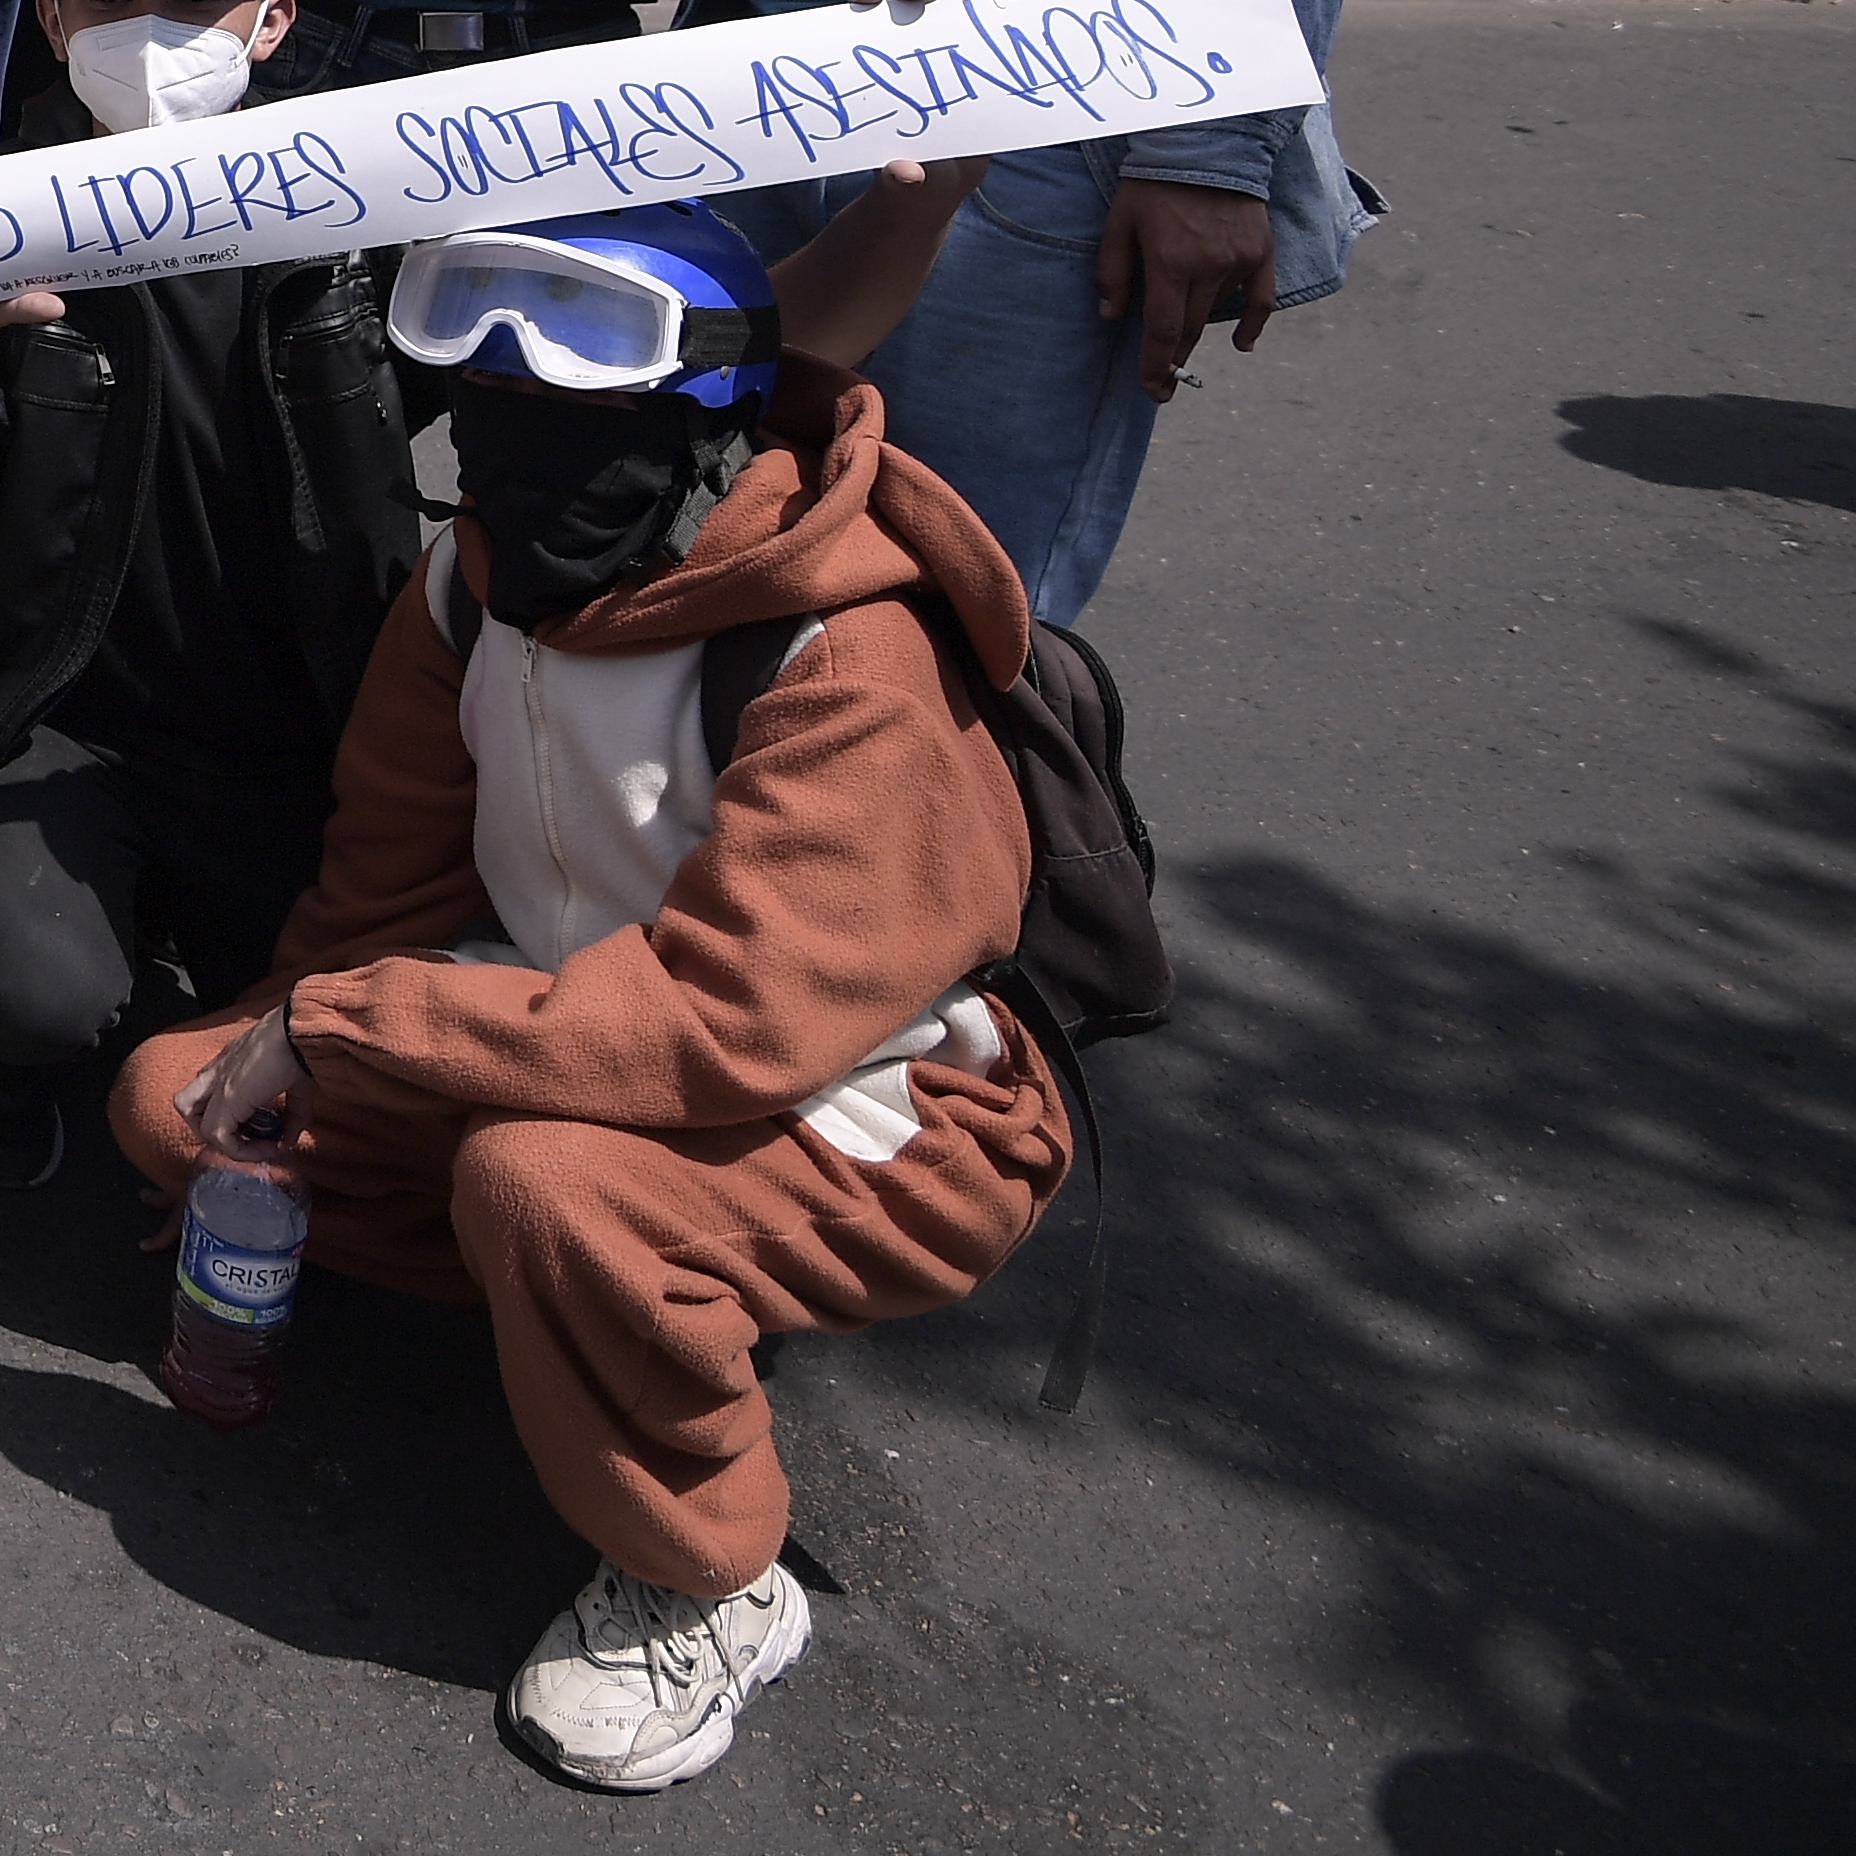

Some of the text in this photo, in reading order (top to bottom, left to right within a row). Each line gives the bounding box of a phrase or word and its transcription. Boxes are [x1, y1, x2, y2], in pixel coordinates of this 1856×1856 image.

[50, 129, 370, 259] LIDERES
[394, 80, 746, 205] SOCIALES
[211, 1258, 297, 1288] CRISTAL
